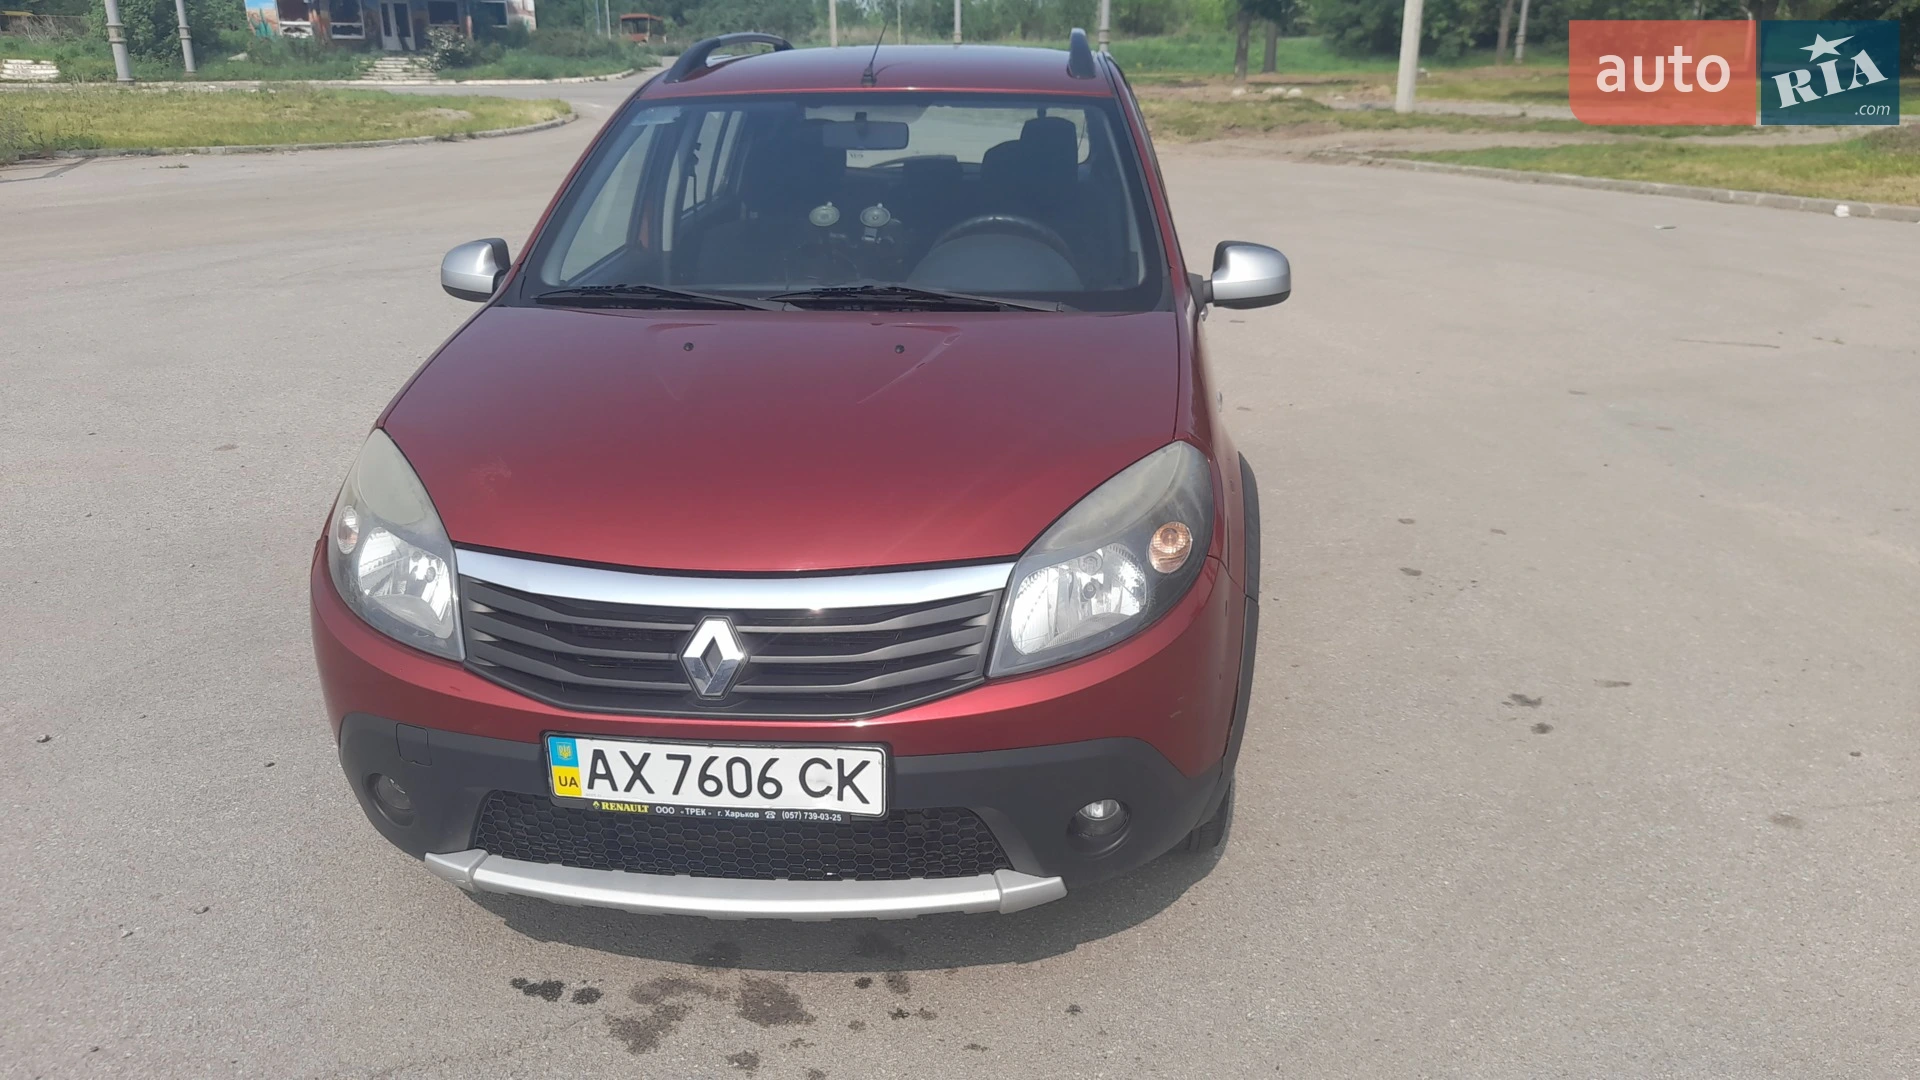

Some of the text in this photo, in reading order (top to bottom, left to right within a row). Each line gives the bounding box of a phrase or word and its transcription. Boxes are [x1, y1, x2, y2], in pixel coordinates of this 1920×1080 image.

[558, 775, 580, 789] UA
[587, 748, 872, 805] AX 7606 CK
[601, 801, 650, 814] RENAULT
[655, 805, 675, 815] ООО
[724, 809, 760, 819] Харьков
[781, 810, 802, 820] (057)
[803, 811, 842, 822] 739-03-25
